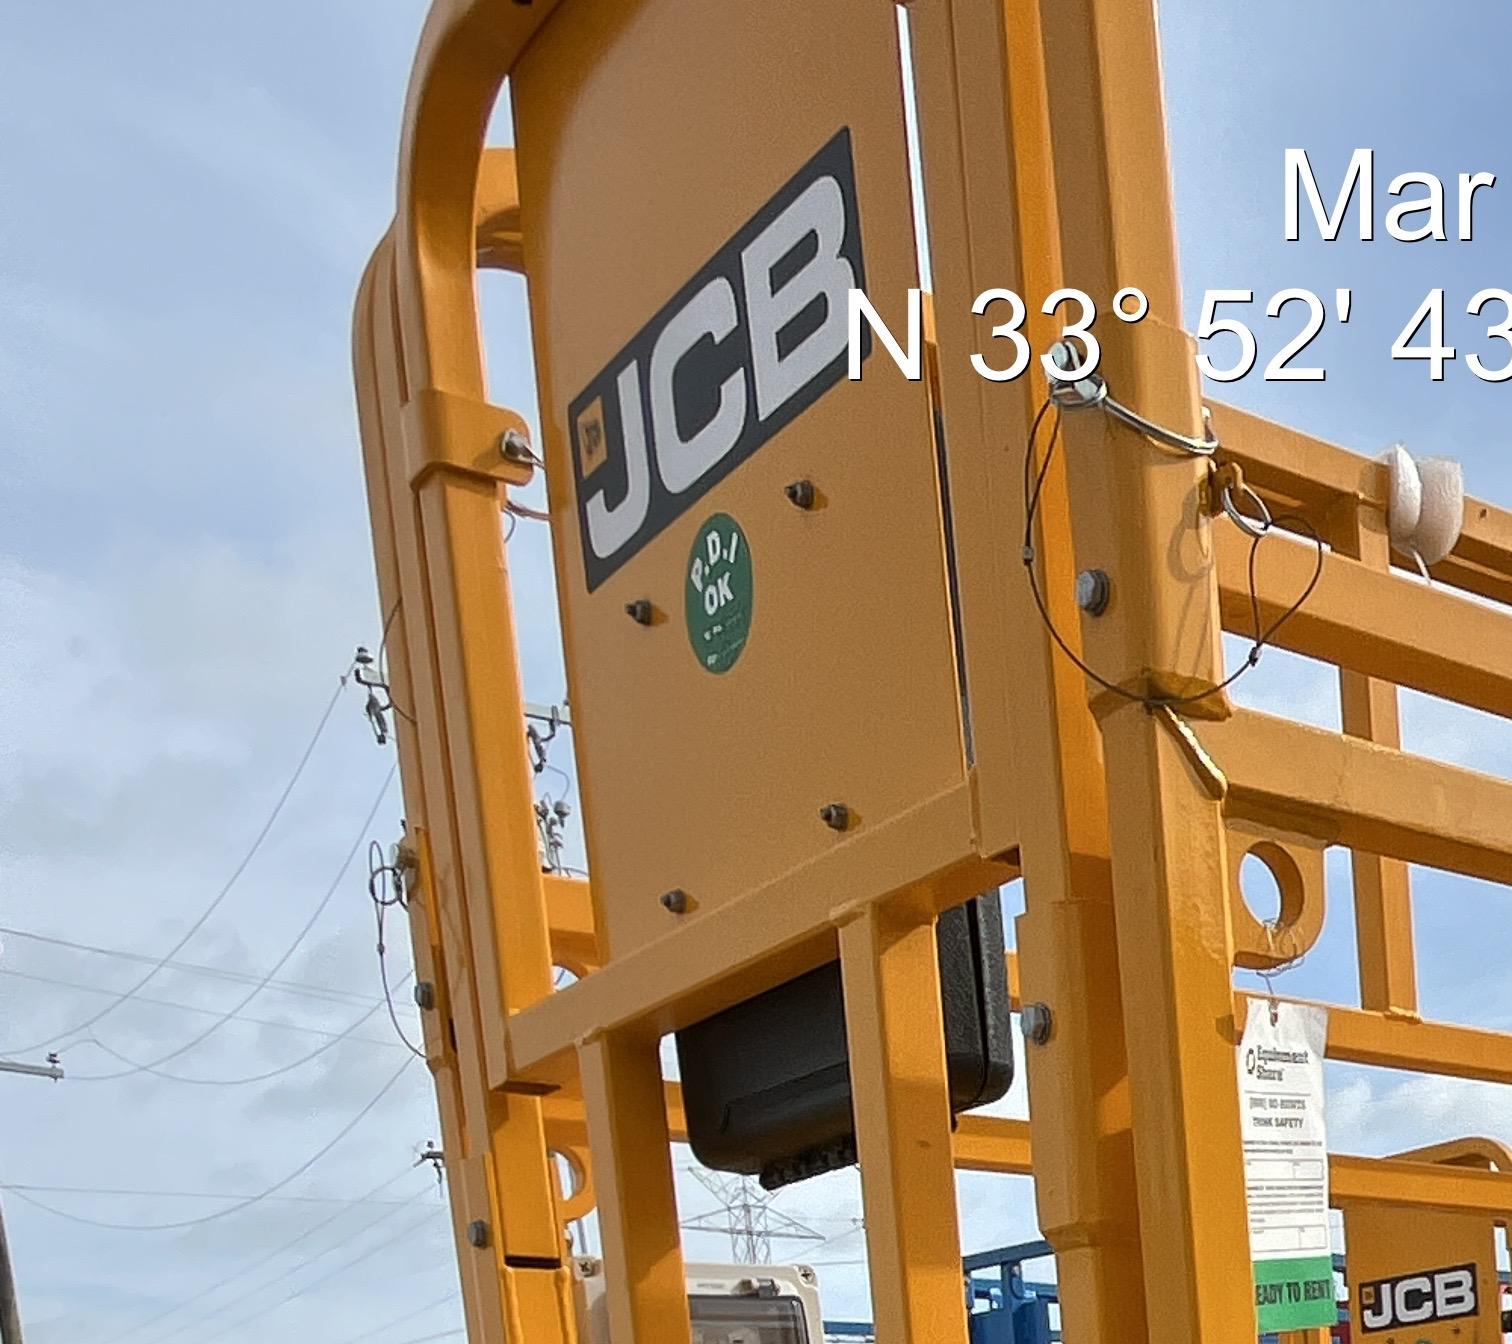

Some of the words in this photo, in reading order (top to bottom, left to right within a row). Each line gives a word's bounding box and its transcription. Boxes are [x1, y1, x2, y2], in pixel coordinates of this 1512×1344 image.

[586, 175, 856, 559] JCB
[704, 571, 734, 616] OK
[1255, 1282, 1283, 1306] EADY
[1286, 1281, 1300, 1303] TO
[1304, 1279, 1331, 1301] RENT
[1363, 1270, 1475, 1329] JCB
